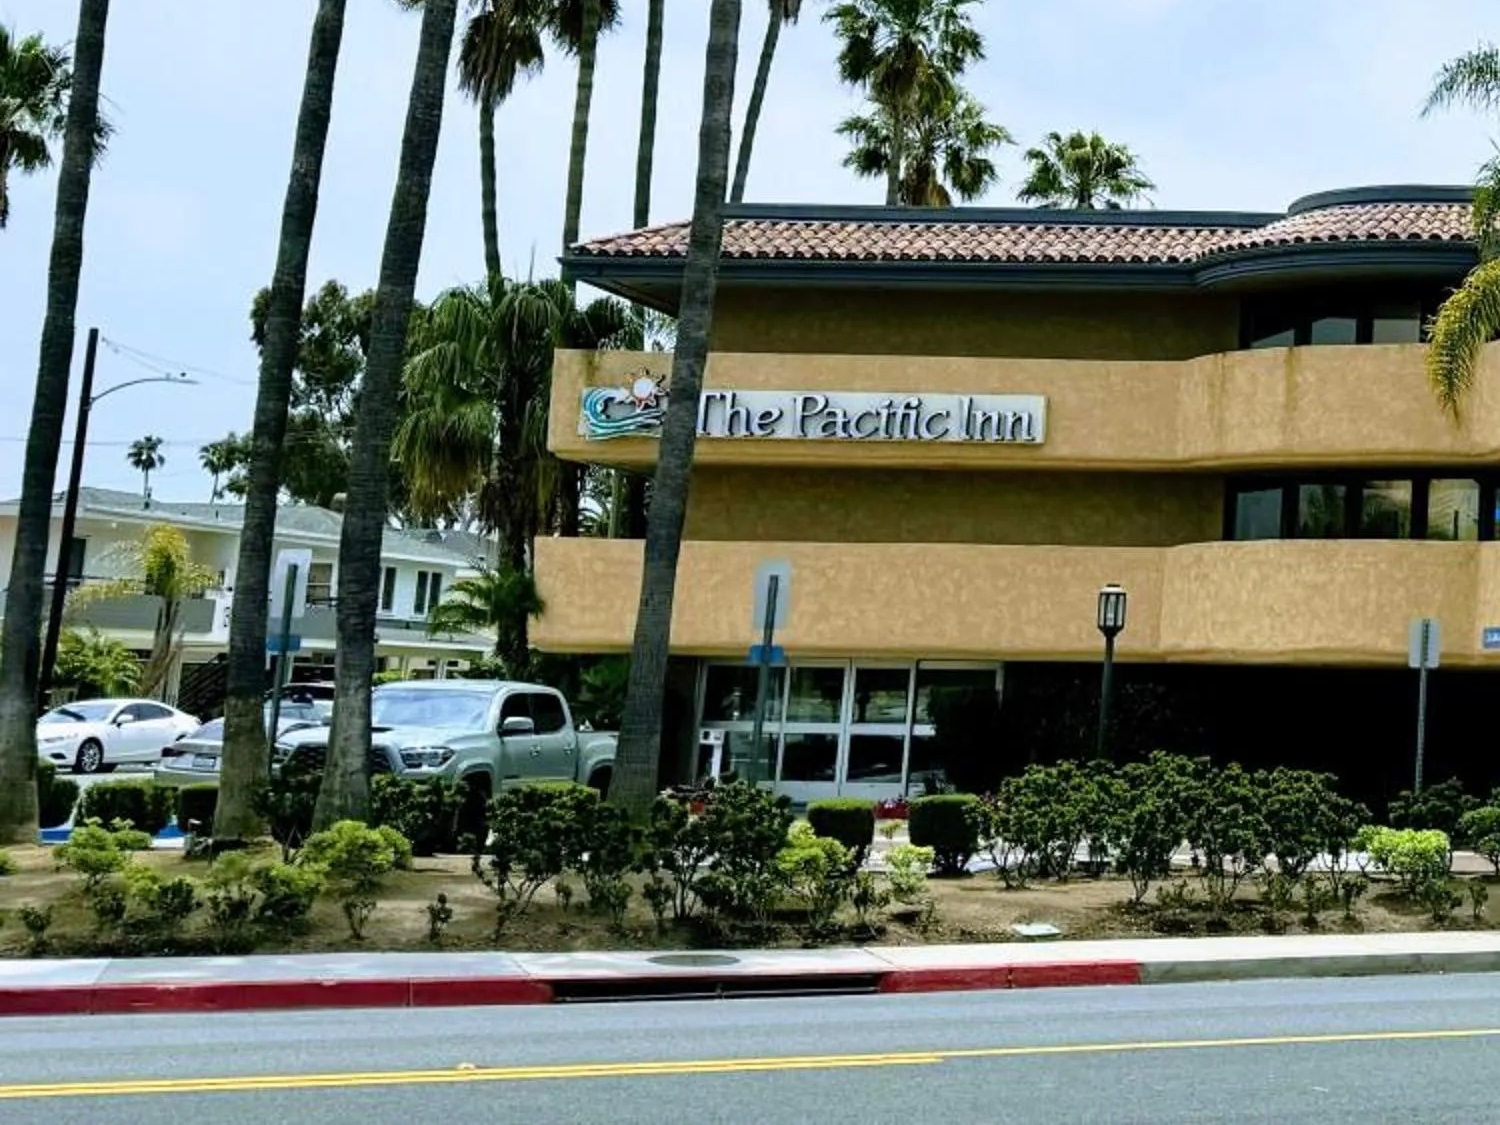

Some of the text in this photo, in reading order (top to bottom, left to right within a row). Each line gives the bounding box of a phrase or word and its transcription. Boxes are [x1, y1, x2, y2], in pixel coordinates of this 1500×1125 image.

[698, 391, 1035, 441] The Pacific Inn
